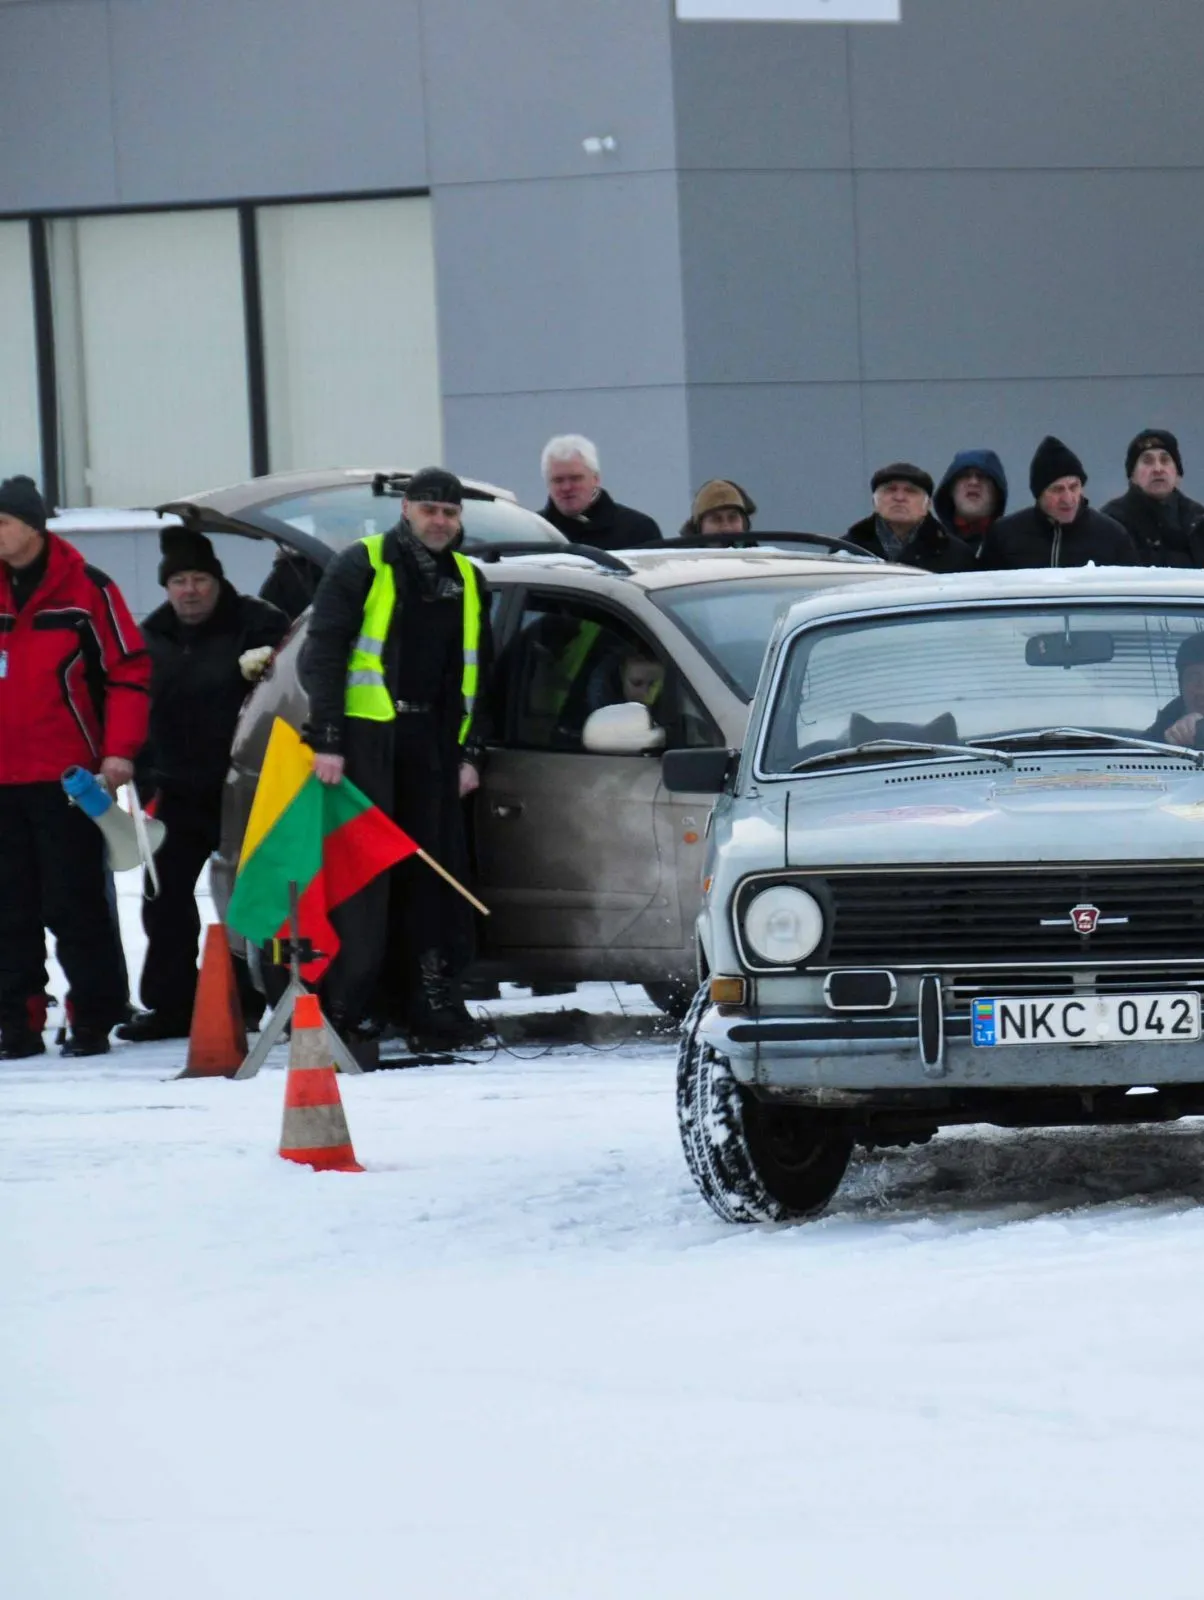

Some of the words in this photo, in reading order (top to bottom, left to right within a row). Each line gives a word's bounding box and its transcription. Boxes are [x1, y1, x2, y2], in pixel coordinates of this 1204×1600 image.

[1000, 1002, 1086, 1039] NKC
[1118, 999, 1191, 1036] 042
[977, 1031, 993, 1042] LT
